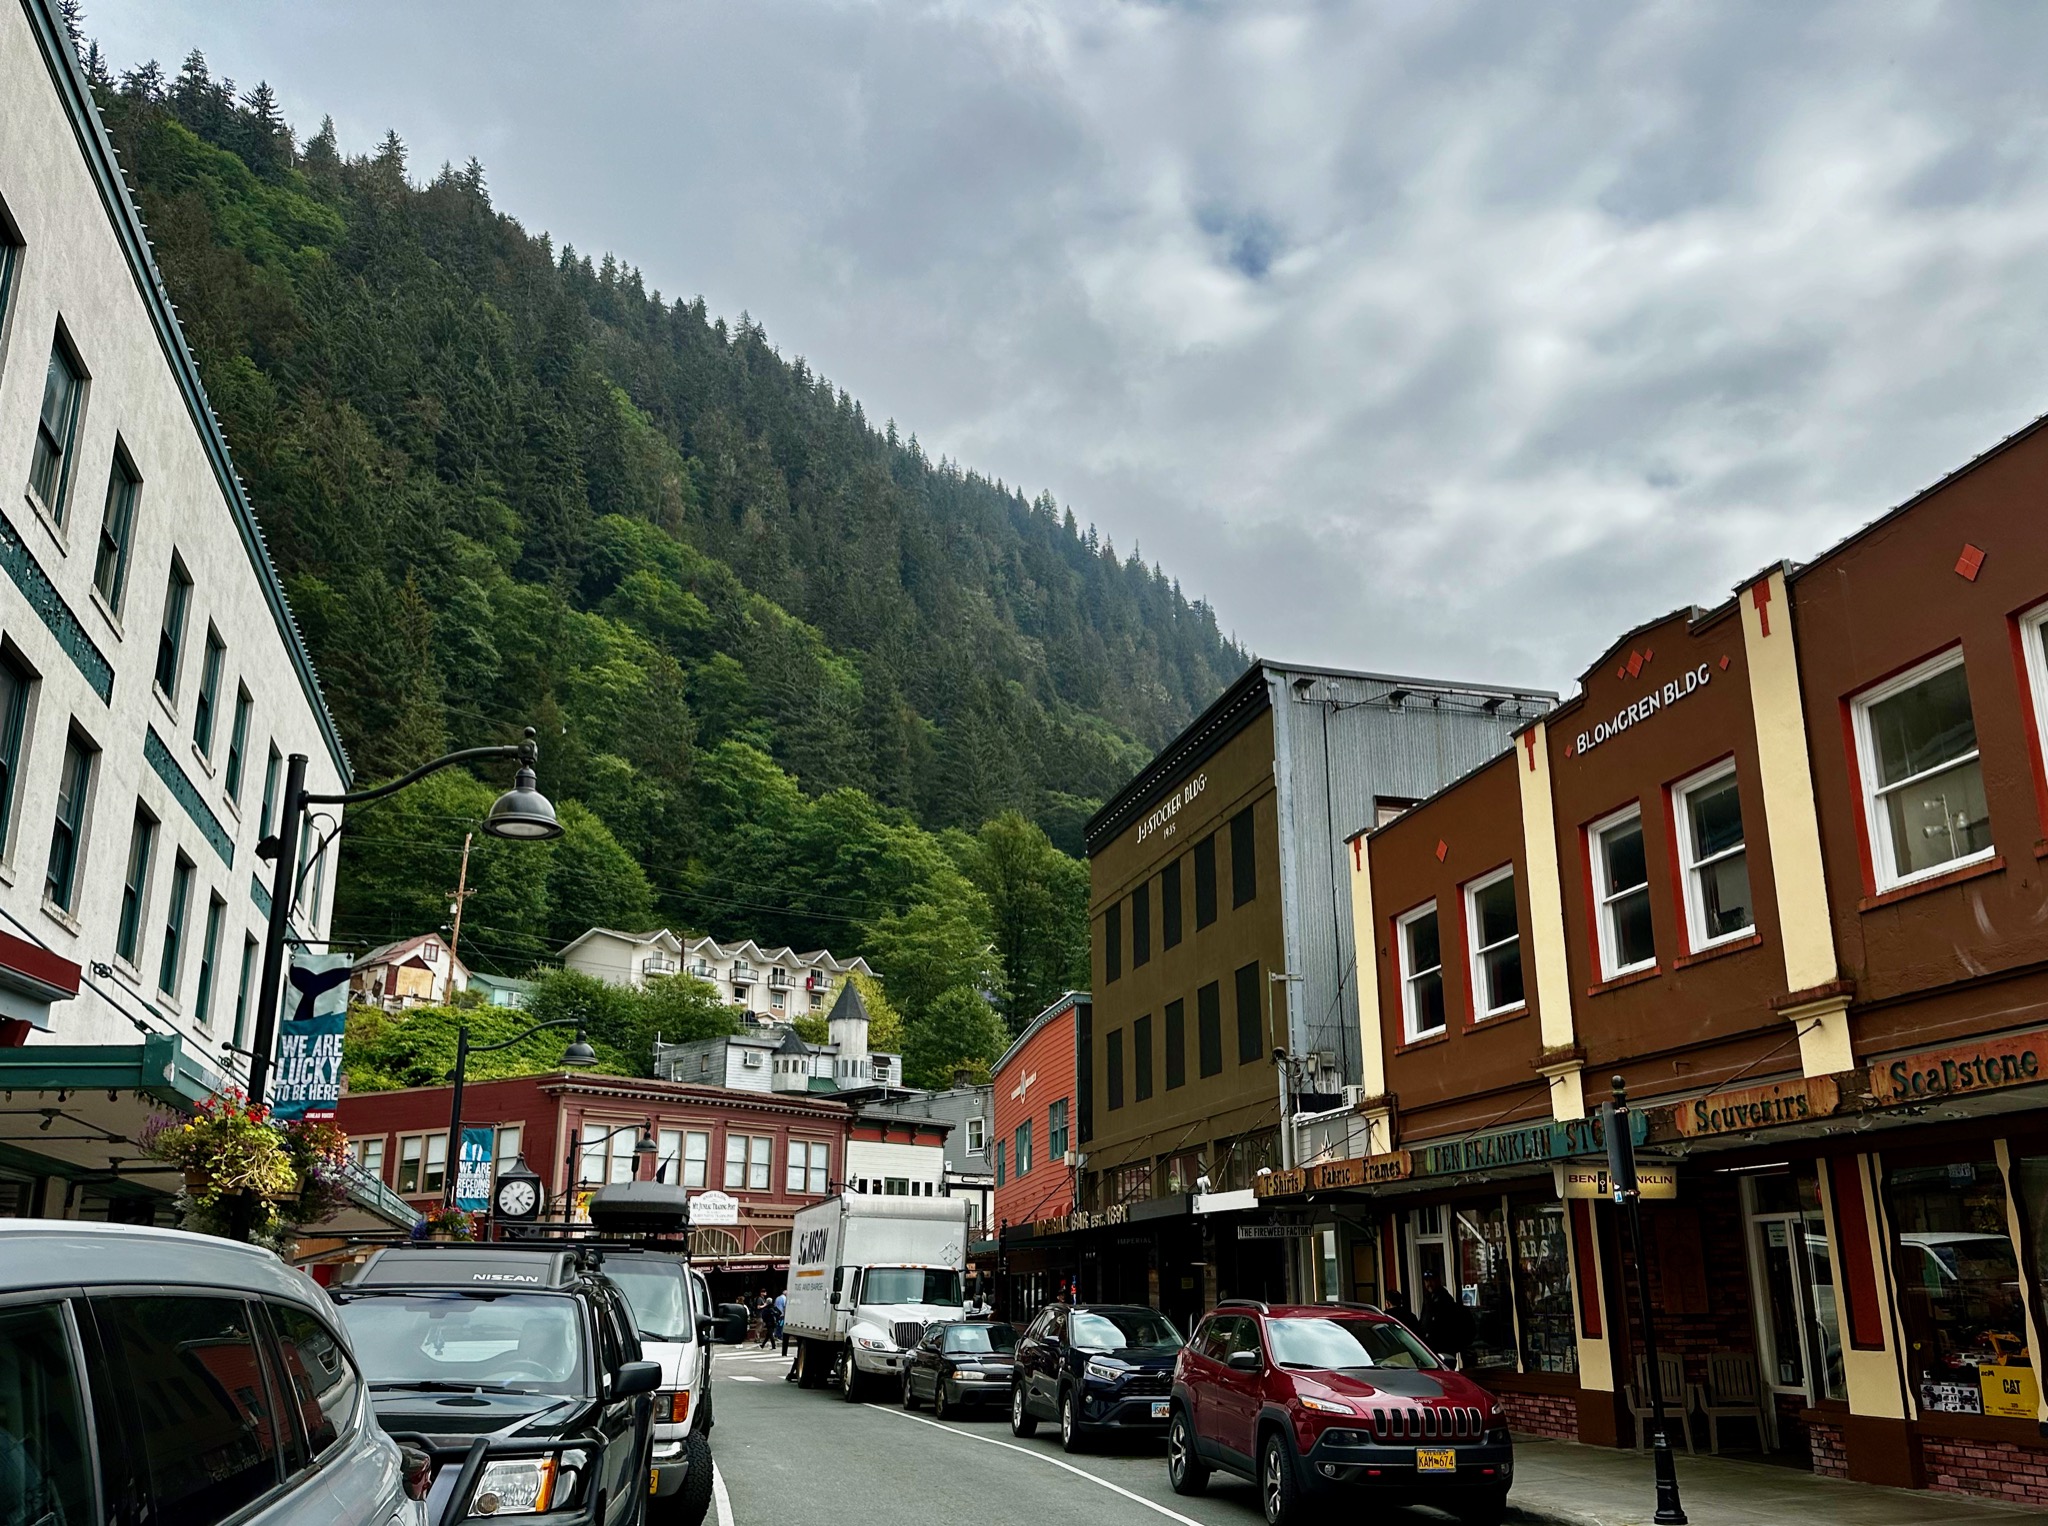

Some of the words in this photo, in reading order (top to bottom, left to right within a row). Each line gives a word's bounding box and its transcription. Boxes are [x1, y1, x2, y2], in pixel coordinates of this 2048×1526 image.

[1576, 690, 1660, 755] BLOMGREN
[1664, 663, 1711, 705] BLDG
[281, 1034, 308, 1058] WE
[312, 1033, 345, 1057] ARE
[275, 1056, 343, 1085] LUCKY
[1890, 1051, 2039, 1099] Soapstone
[275, 1084, 290, 1101] TO
[292, 1084, 307, 1100] BE
[309, 1084, 340, 1101] HERE
[1694, 1087, 1809, 1132] Souvenirs
[1464, 1128, 1551, 1168] FRANKLIN
[1566, 1118, 1605, 1152] STO
[459, 1161, 473, 1173] WE
[475, 1162, 492, 1173] ARE
[1362, 1159, 1400, 1181] Frames
[456, 1178, 490, 1189] RECEDING
[1264, 1175, 1299, 1195] T-Shirts
[1568, 1174, 1596, 1184] BEN
[456, 1188, 489, 1198] GLACIERS
[1241, 1227, 1252, 1237] THE
[1254, 1227, 1285, 1237] FIREWEED
[1286, 1226, 1312, 1236] FACTORY
[472, 1274, 539, 1283] NISSAN
[2003, 1379, 2020, 1394] CAT
[1419, 1456, 1434, 1467] KAM
[1440, 1456, 1453, 1467] 674
